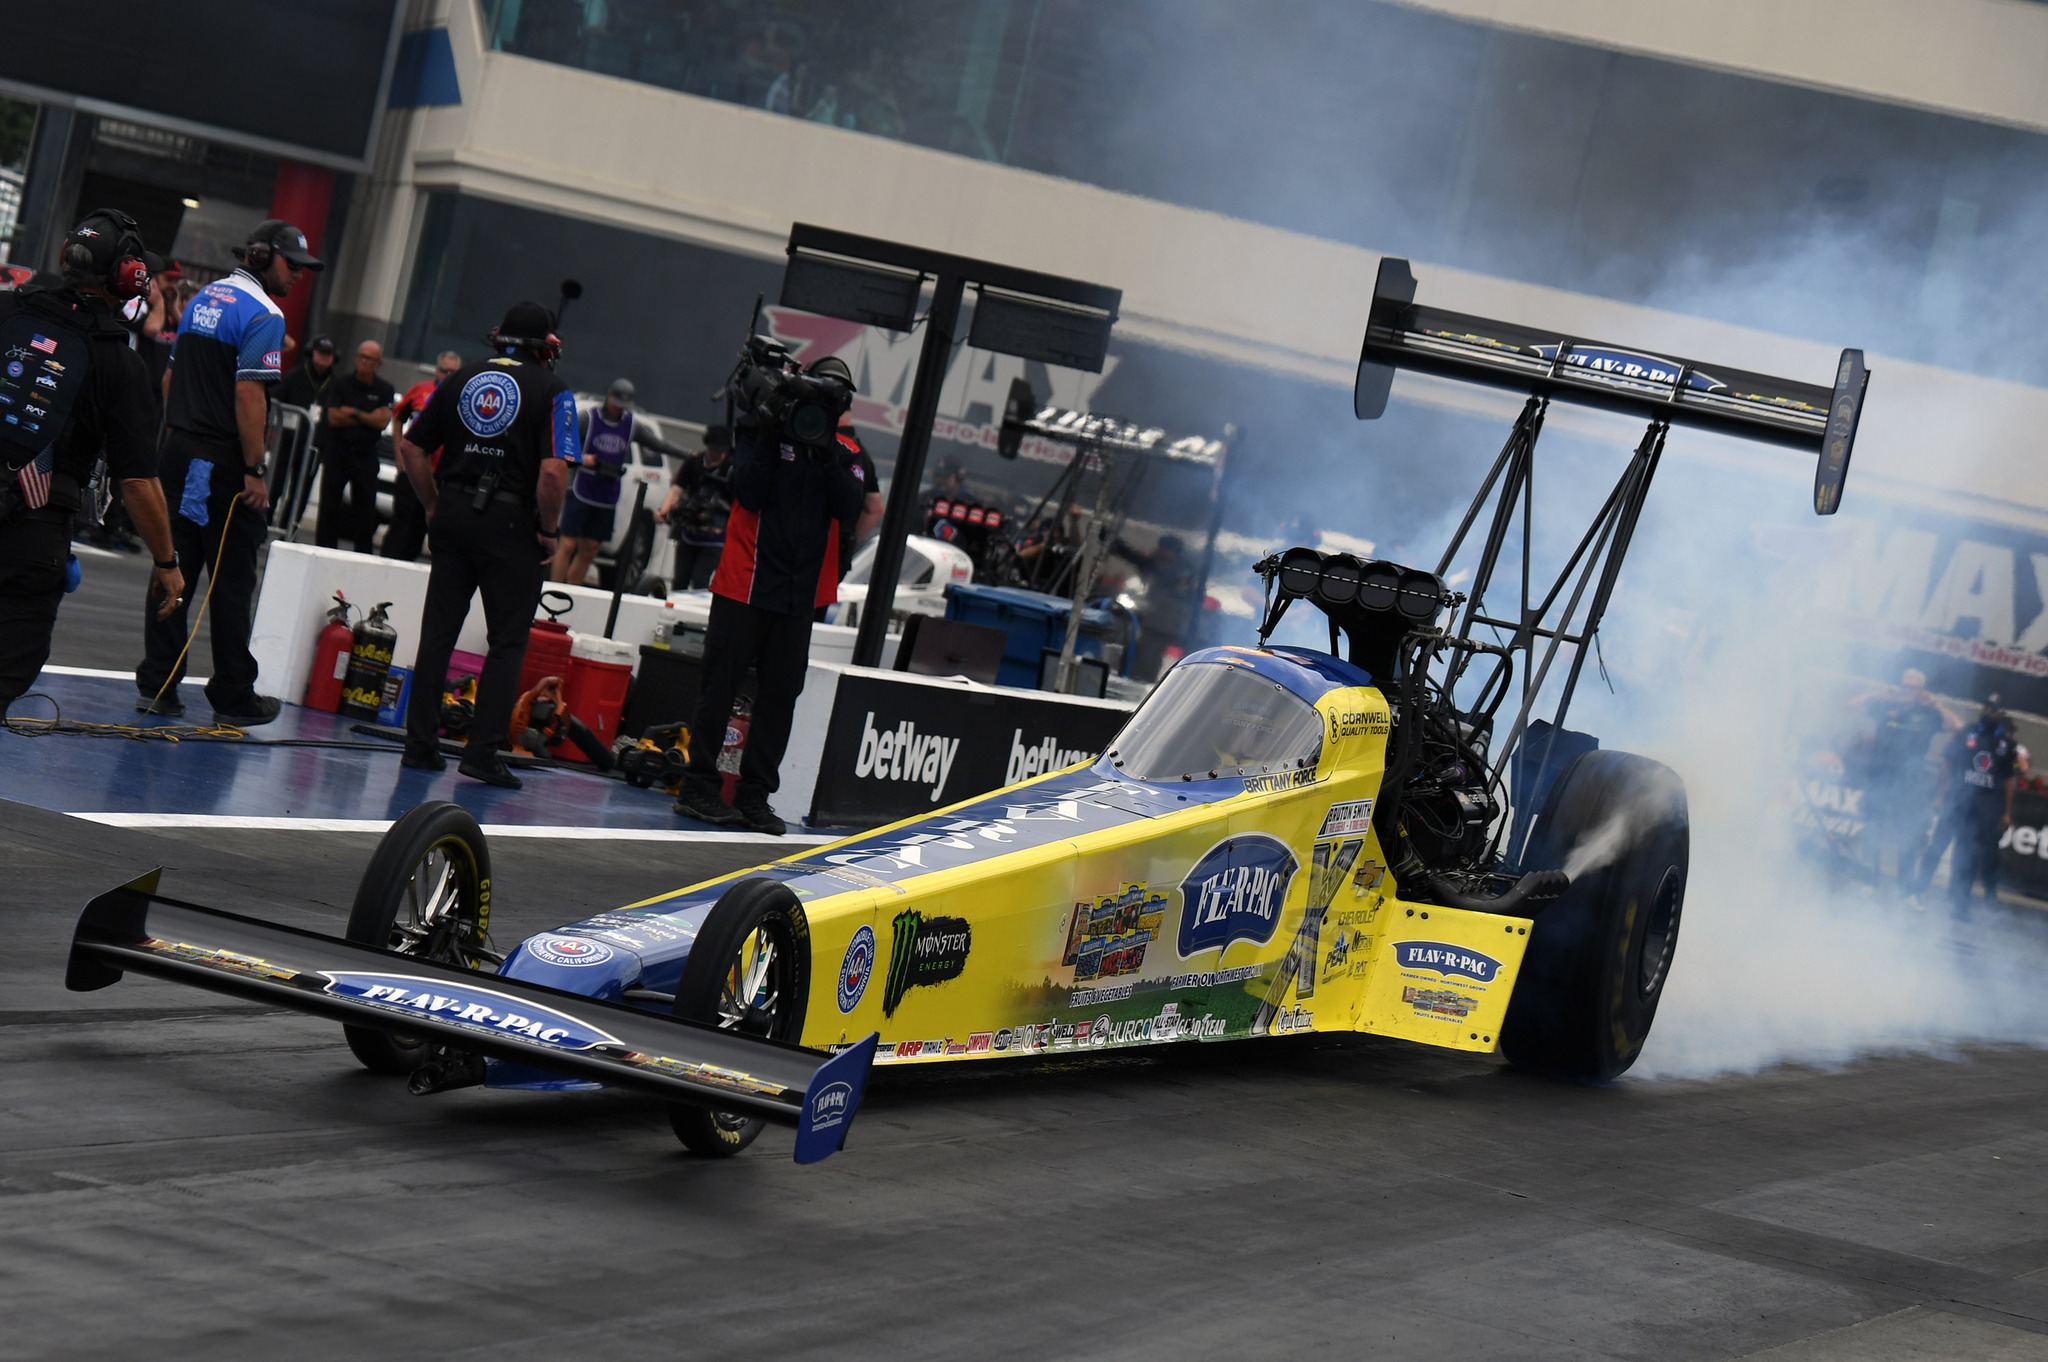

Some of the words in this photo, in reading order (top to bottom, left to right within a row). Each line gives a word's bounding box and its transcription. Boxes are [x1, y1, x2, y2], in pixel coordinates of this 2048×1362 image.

[476, 394, 501, 409] AAA
[26, 404, 47, 417] RAT
[1342, 712, 1388, 724] CORNWELL
[1341, 727, 1368, 736] QUALITY
[1370, 725, 1388, 735] TOOLS
[855, 711, 960, 802] betway
[1243, 773, 1290, 793] BRITTANY
[1293, 766, 1316, 784] FORCE
[1353, 803, 1371, 819] SMITH
[788, 905, 807, 940] EAGLE
[1338, 910, 1376, 925] CHEVROLET
[554, 940, 590, 954] AAA
[919, 960, 956, 972] ENERGY
[1324, 943, 1350, 975] PEAK
[849, 956, 865, 978] AAA
[1171, 974, 1199, 988] FARMER
[1420, 975, 1437, 983] OWNED
[1440, 979, 1468, 989] NORTHWEST
[1435, 1016, 1463, 1024] VEGETABLES
[897, 1041, 923, 1056] ARP
